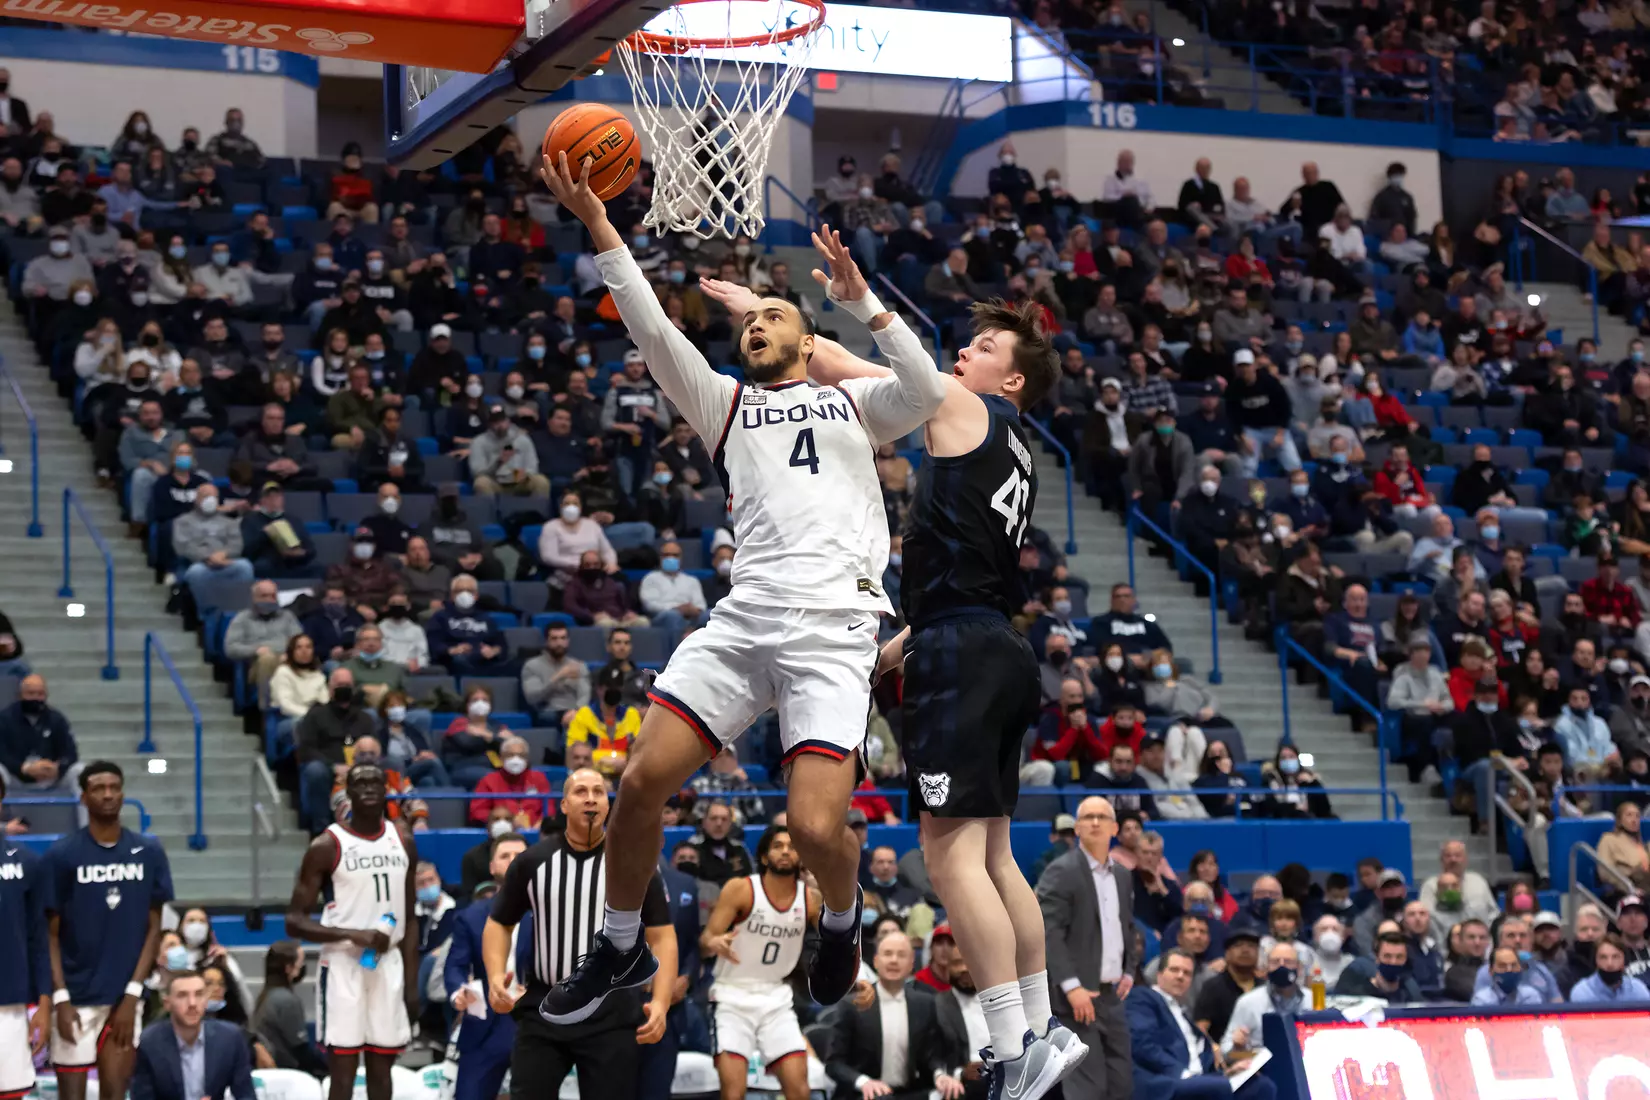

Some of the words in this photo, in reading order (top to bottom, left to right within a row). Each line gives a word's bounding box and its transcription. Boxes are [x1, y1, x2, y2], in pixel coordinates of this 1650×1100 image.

[222, 45, 280, 72] 115
[1087, 102, 1137, 128] 116
[742, 403, 850, 429] UCONN
[789, 427, 820, 475] 4
[77, 863, 144, 883] UCONN
[346, 855, 407, 872] UCONN
[372, 873, 390, 902] 11
[747, 921, 802, 938] UCONN
[762, 941, 780, 964] 0
